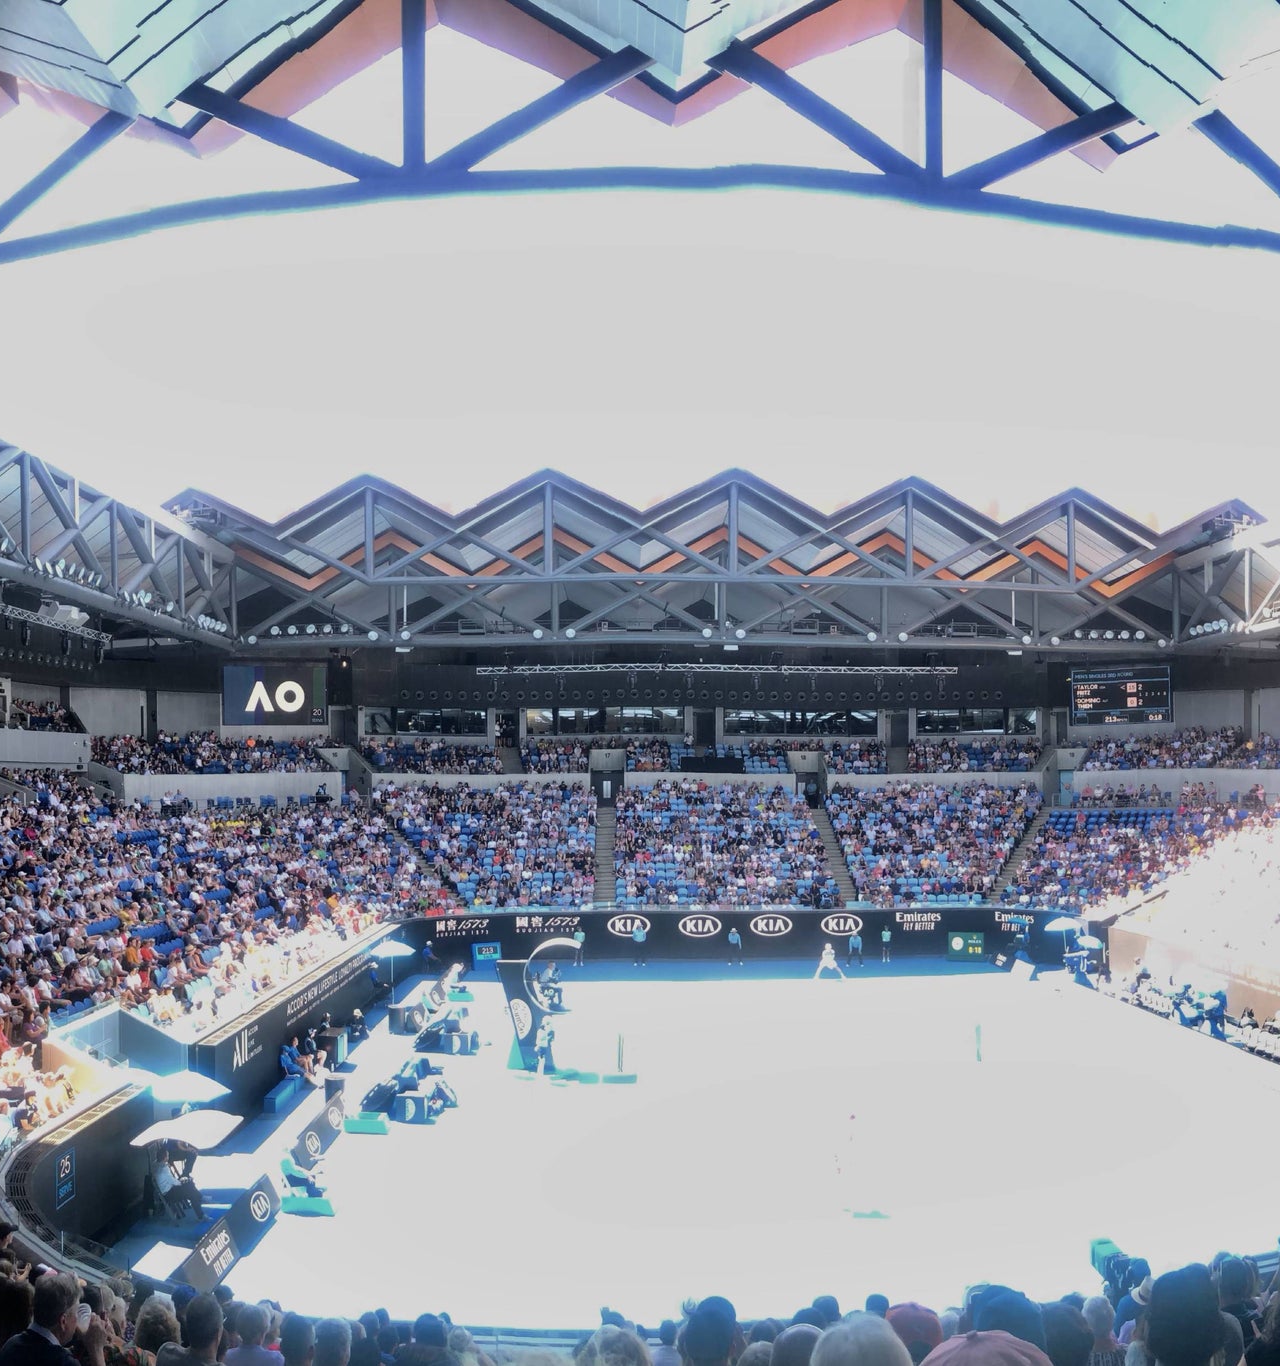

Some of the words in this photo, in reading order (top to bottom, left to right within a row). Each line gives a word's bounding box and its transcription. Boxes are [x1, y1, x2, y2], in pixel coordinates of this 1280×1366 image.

[896, 912, 941, 922] Emirates
[686, 919, 714, 932] KIA
[757, 919, 785, 932] KIA
[828, 918, 856, 931] KIA
[914, 922, 934, 930] BETTER
[1001, 923, 1009, 931] FLY
[286, 992, 308, 1017] ACCOR'S
[307, 986, 318, 1002] NEW
[318, 971, 338, 994] LIFESTYLE
[61, 1155, 70, 1177] 25
[252, 1196, 268, 1218] KIA
[200, 1230, 230, 1265] Emirates
